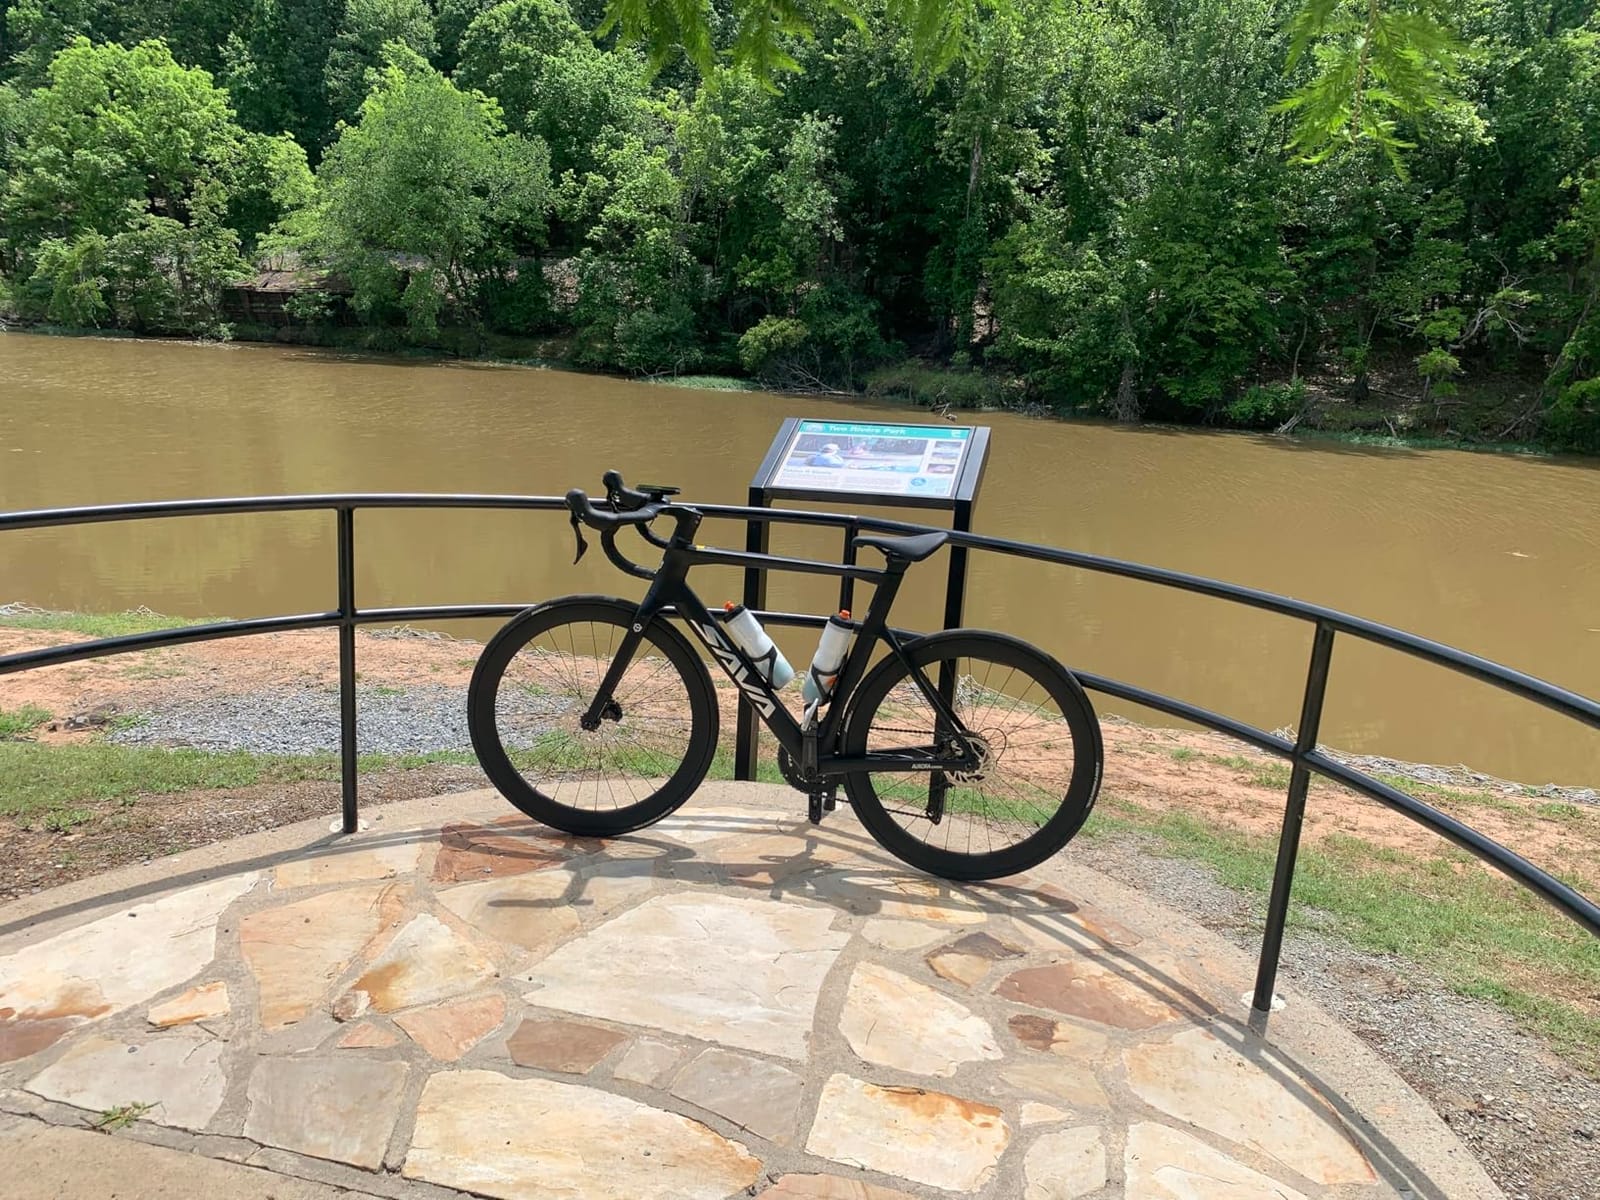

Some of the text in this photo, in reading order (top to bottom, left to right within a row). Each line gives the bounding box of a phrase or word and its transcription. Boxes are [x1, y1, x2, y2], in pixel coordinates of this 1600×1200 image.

[829, 425, 906, 435] Two Rivers Park
[690, 618, 777, 719] SAVA
